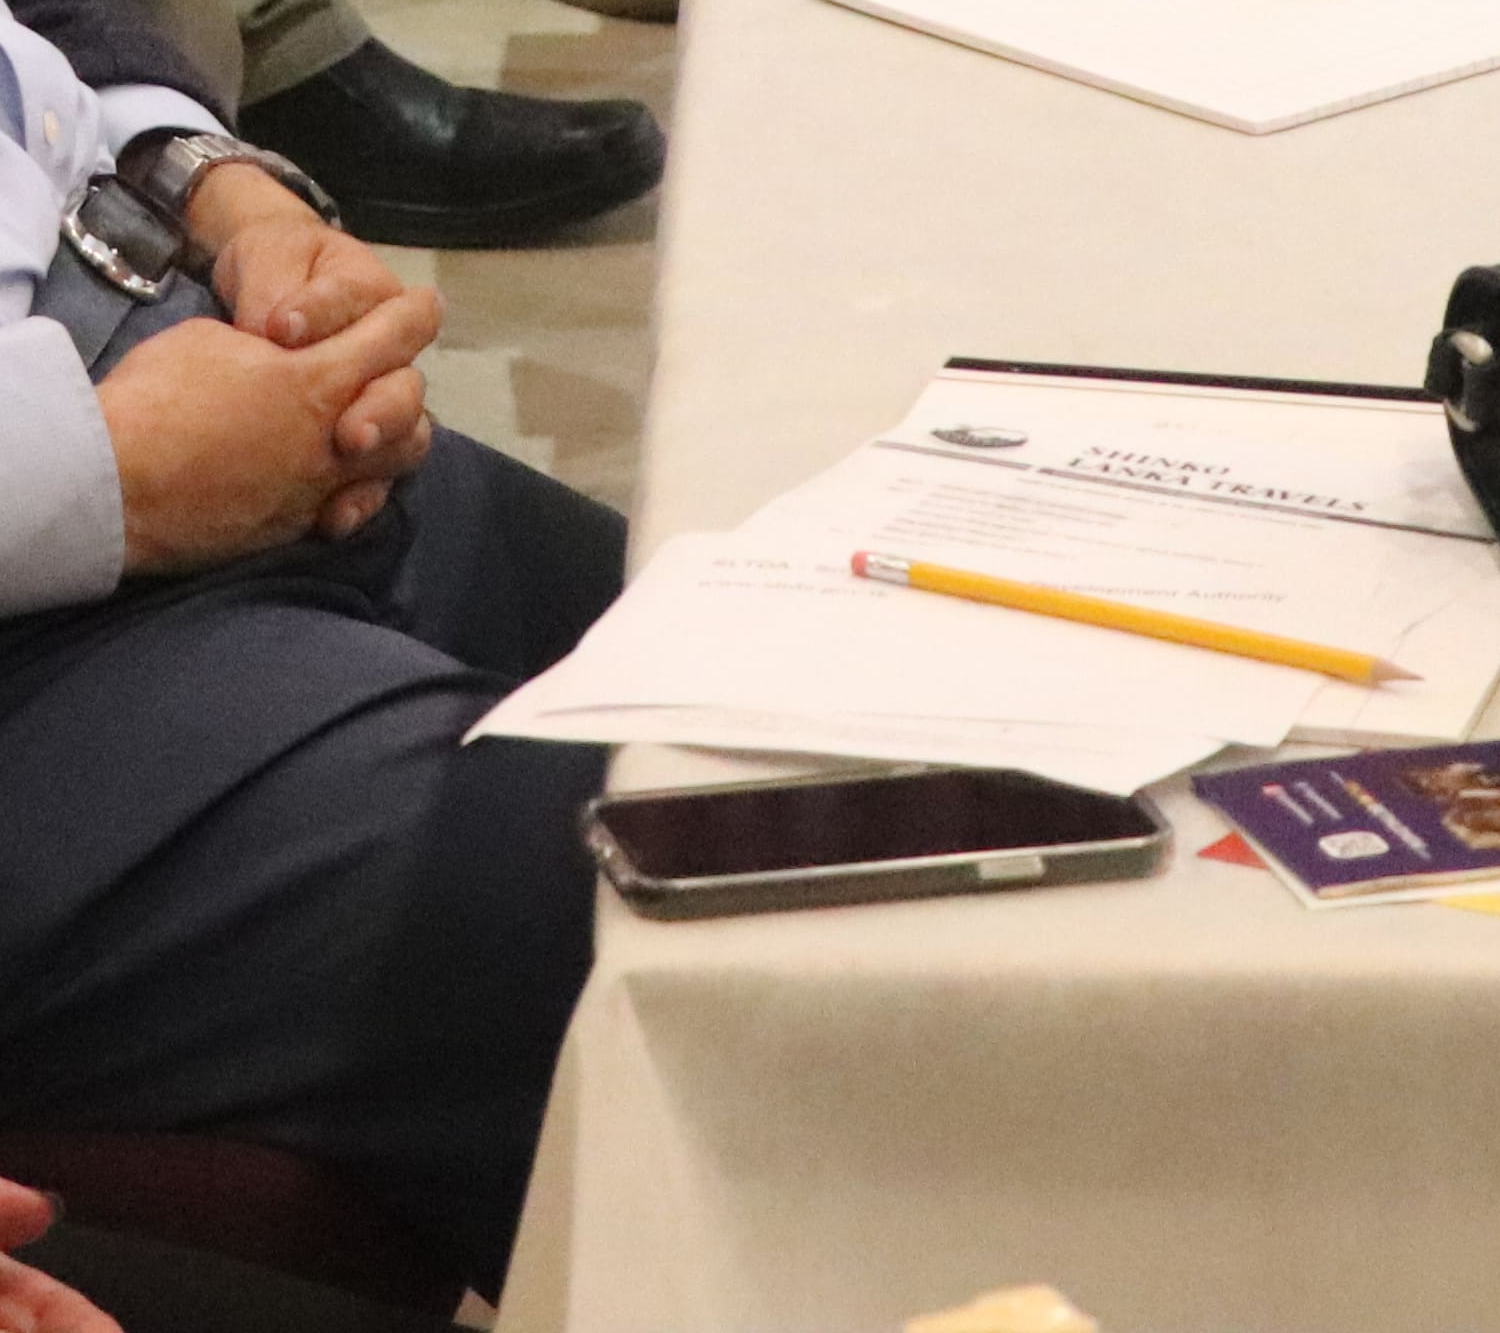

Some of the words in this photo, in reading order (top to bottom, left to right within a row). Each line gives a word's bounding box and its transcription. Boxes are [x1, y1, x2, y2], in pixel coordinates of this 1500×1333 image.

[1083, 445, 1231, 476] SHINKO
[1067, 457, 1191, 487] LANKA
[1210, 481, 1370, 511] TRAVELS
